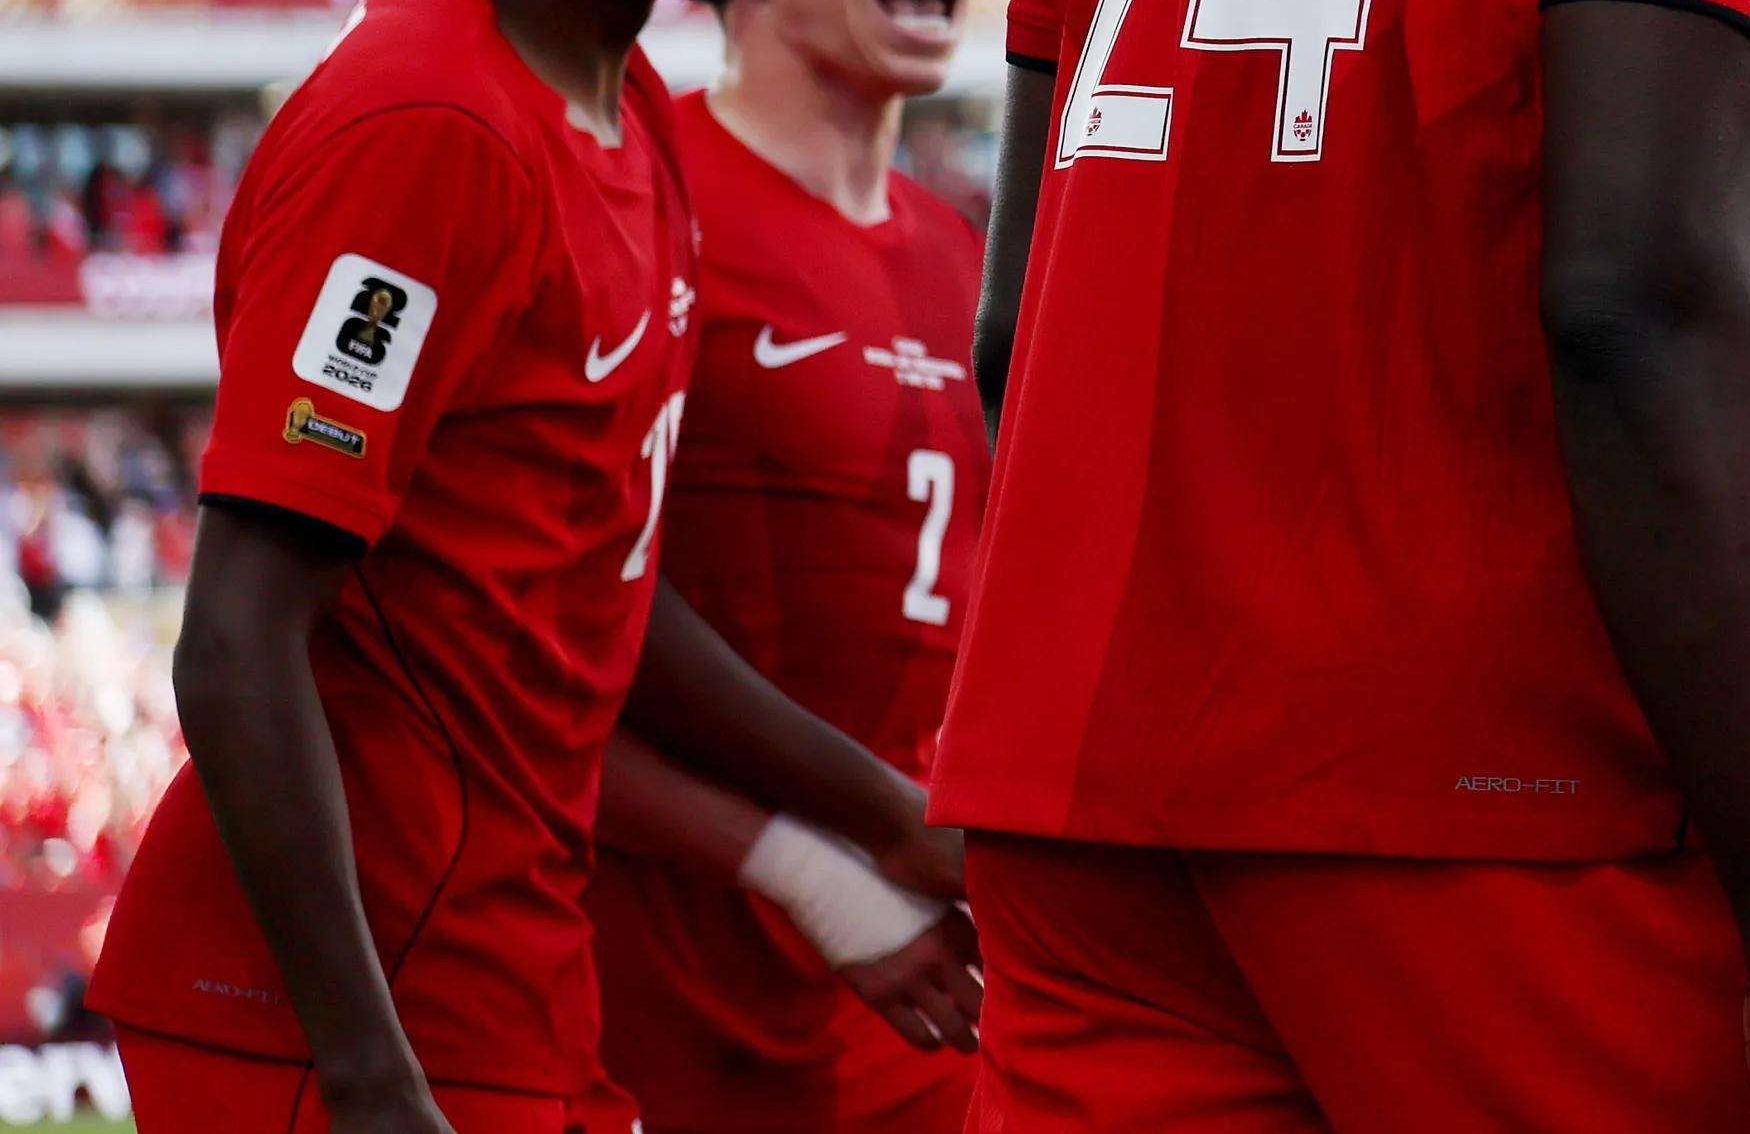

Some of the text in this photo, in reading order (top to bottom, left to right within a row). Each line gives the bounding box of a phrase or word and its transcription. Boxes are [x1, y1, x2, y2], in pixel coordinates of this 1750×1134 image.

[323, 364, 373, 391] 2026
[308, 418, 361, 445] DEBUT
[902, 449, 955, 626] 2
[1455, 776, 1581, 795] AERO-FIT
